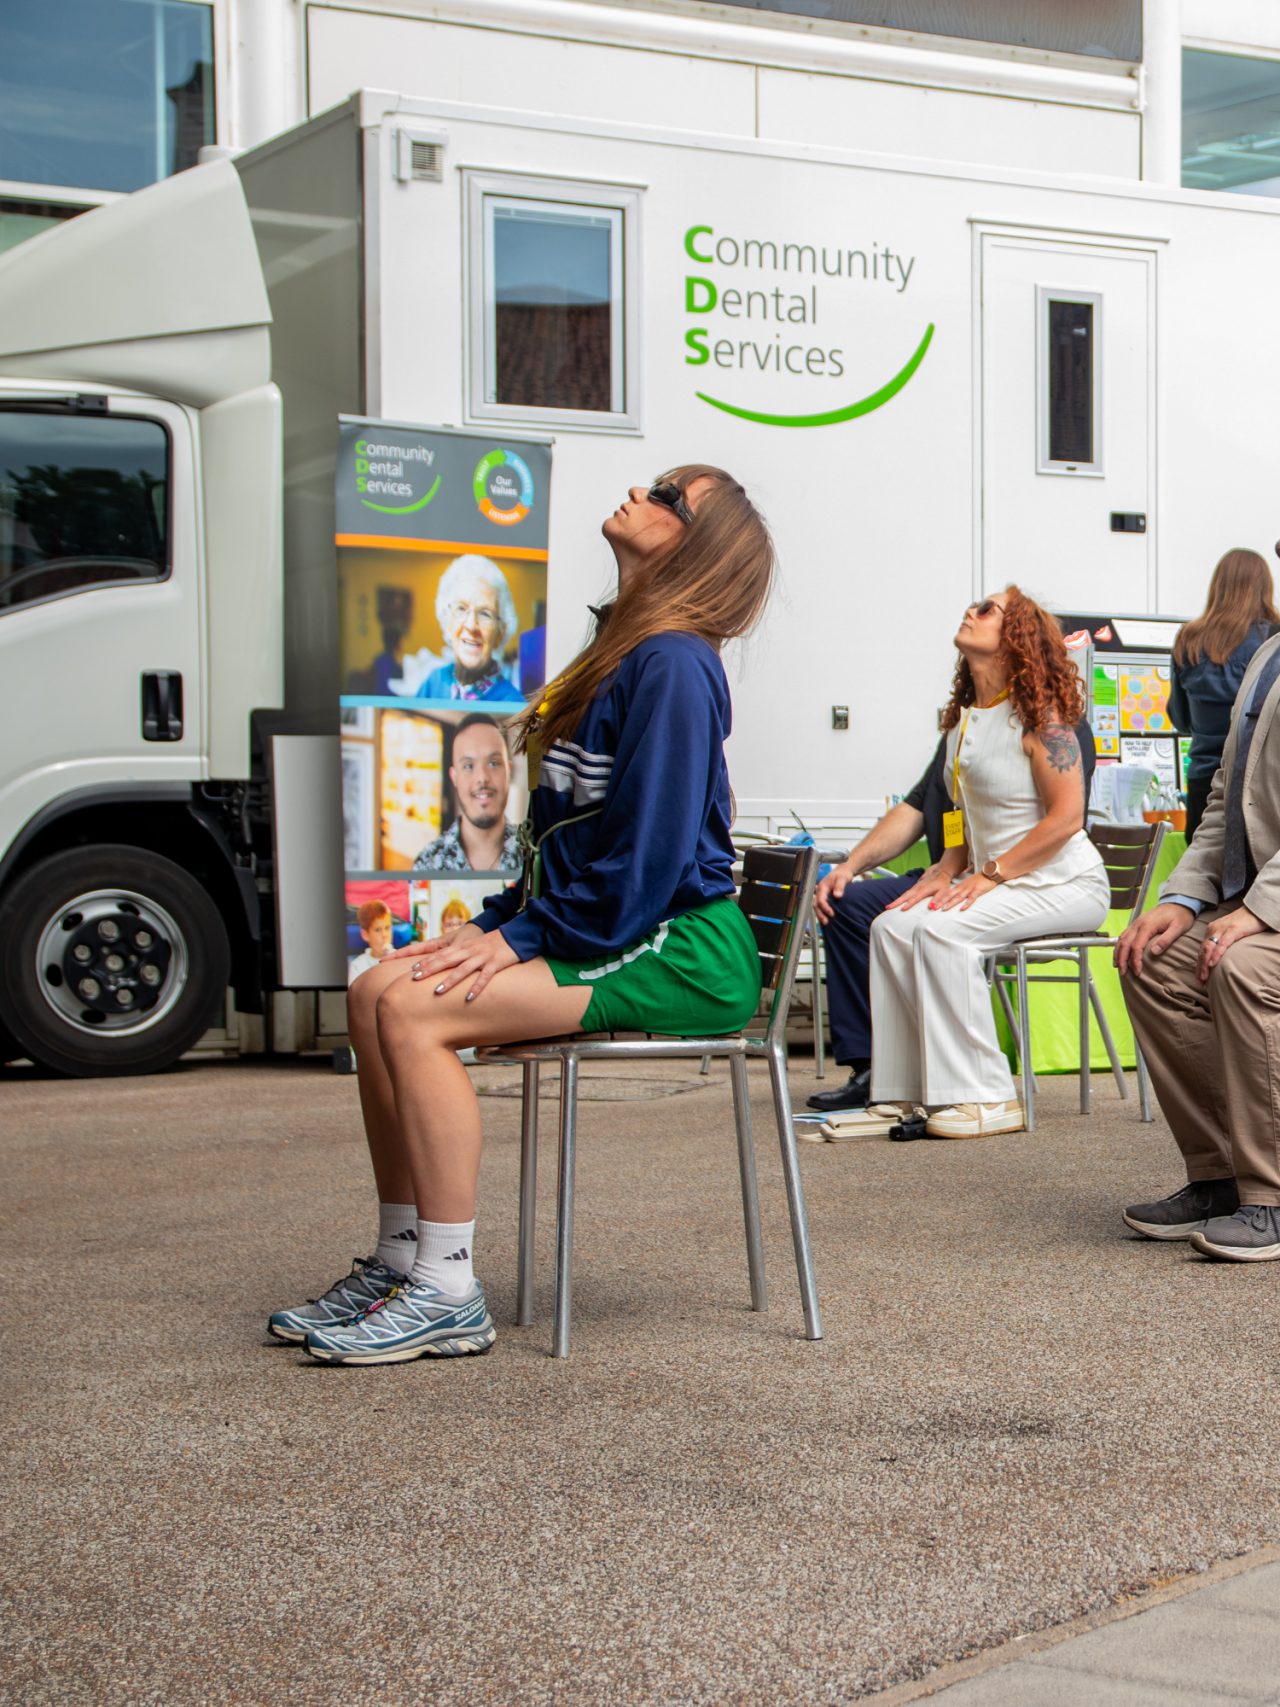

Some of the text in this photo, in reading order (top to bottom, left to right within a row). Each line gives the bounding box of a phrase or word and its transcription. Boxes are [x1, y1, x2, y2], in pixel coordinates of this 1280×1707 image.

[683, 225, 915, 293] Community
[684, 275, 817, 325] Dental
[684, 327, 845, 378] Services
[354, 440, 434, 467] Community
[355, 458, 404, 478] Dental
[356, 476, 413, 497] Services
[490, 484, 519, 497] Values
[496, 475, 512, 486] Our
